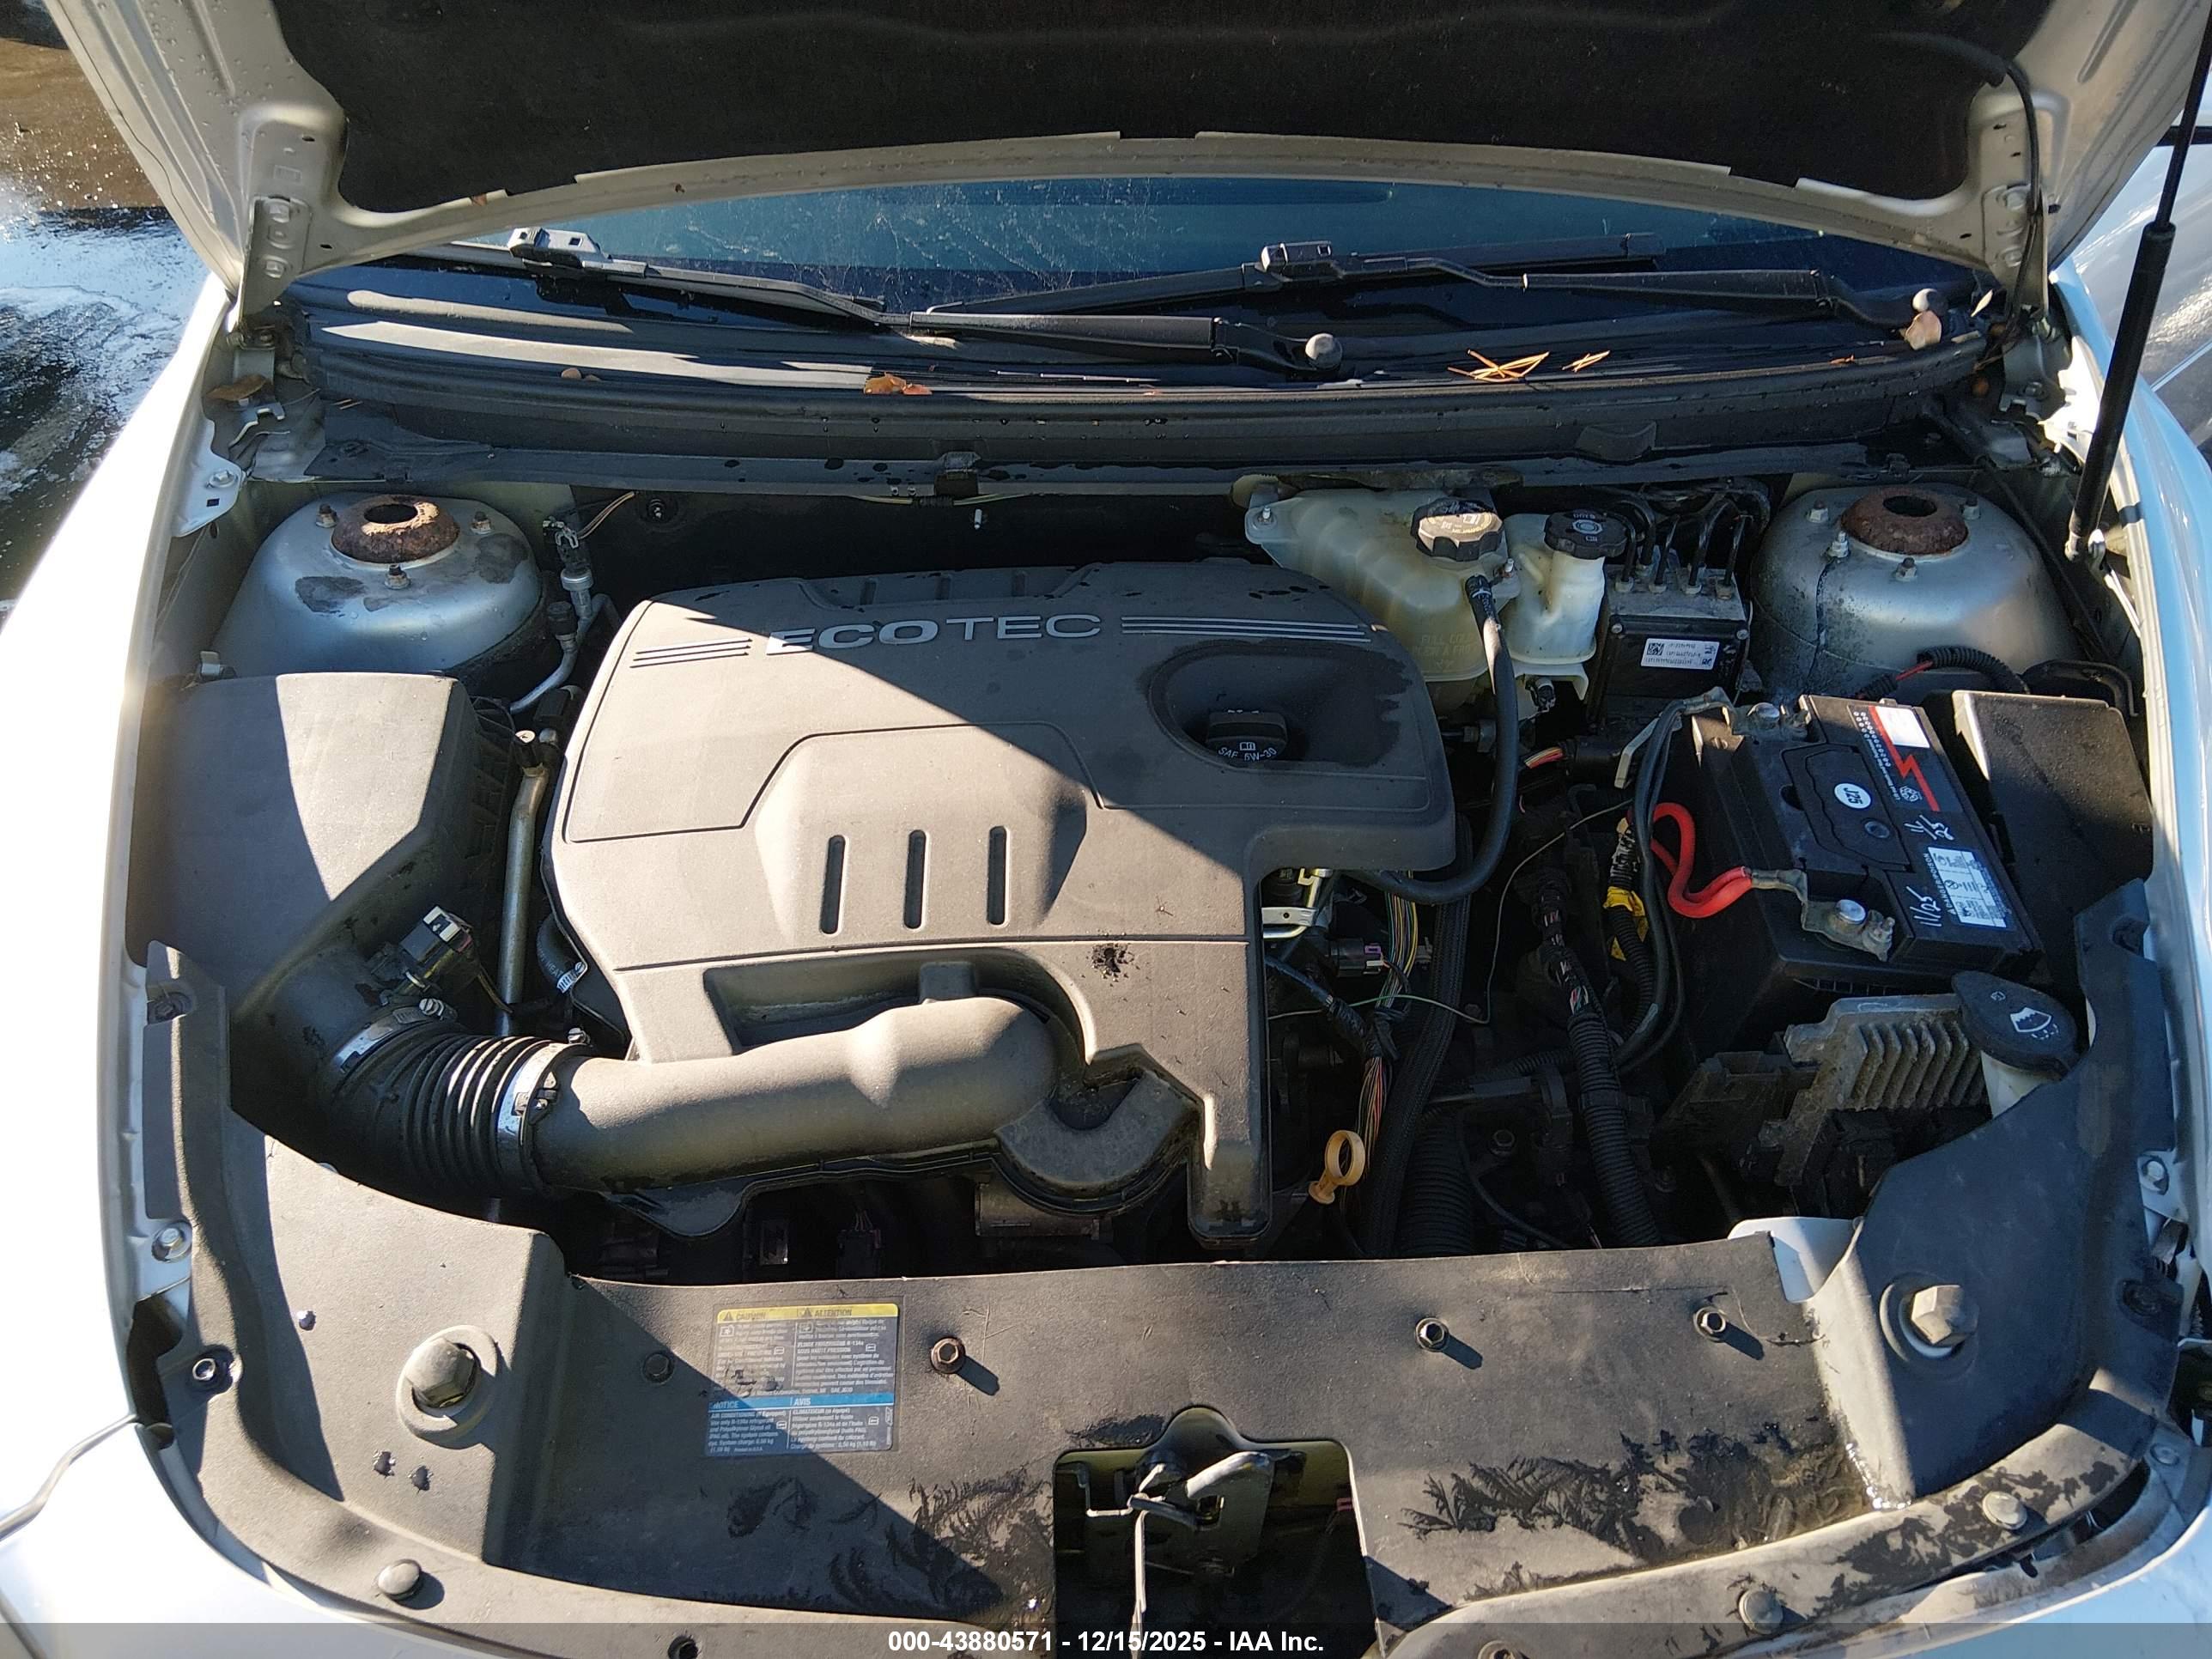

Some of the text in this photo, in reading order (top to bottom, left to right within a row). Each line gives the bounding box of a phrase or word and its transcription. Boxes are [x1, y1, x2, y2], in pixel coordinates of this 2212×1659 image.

[765, 613, 1102, 656] ECOTEC
[1843, 787, 1863, 805] J25
[712, 1401, 739, 1409] NOTICE
